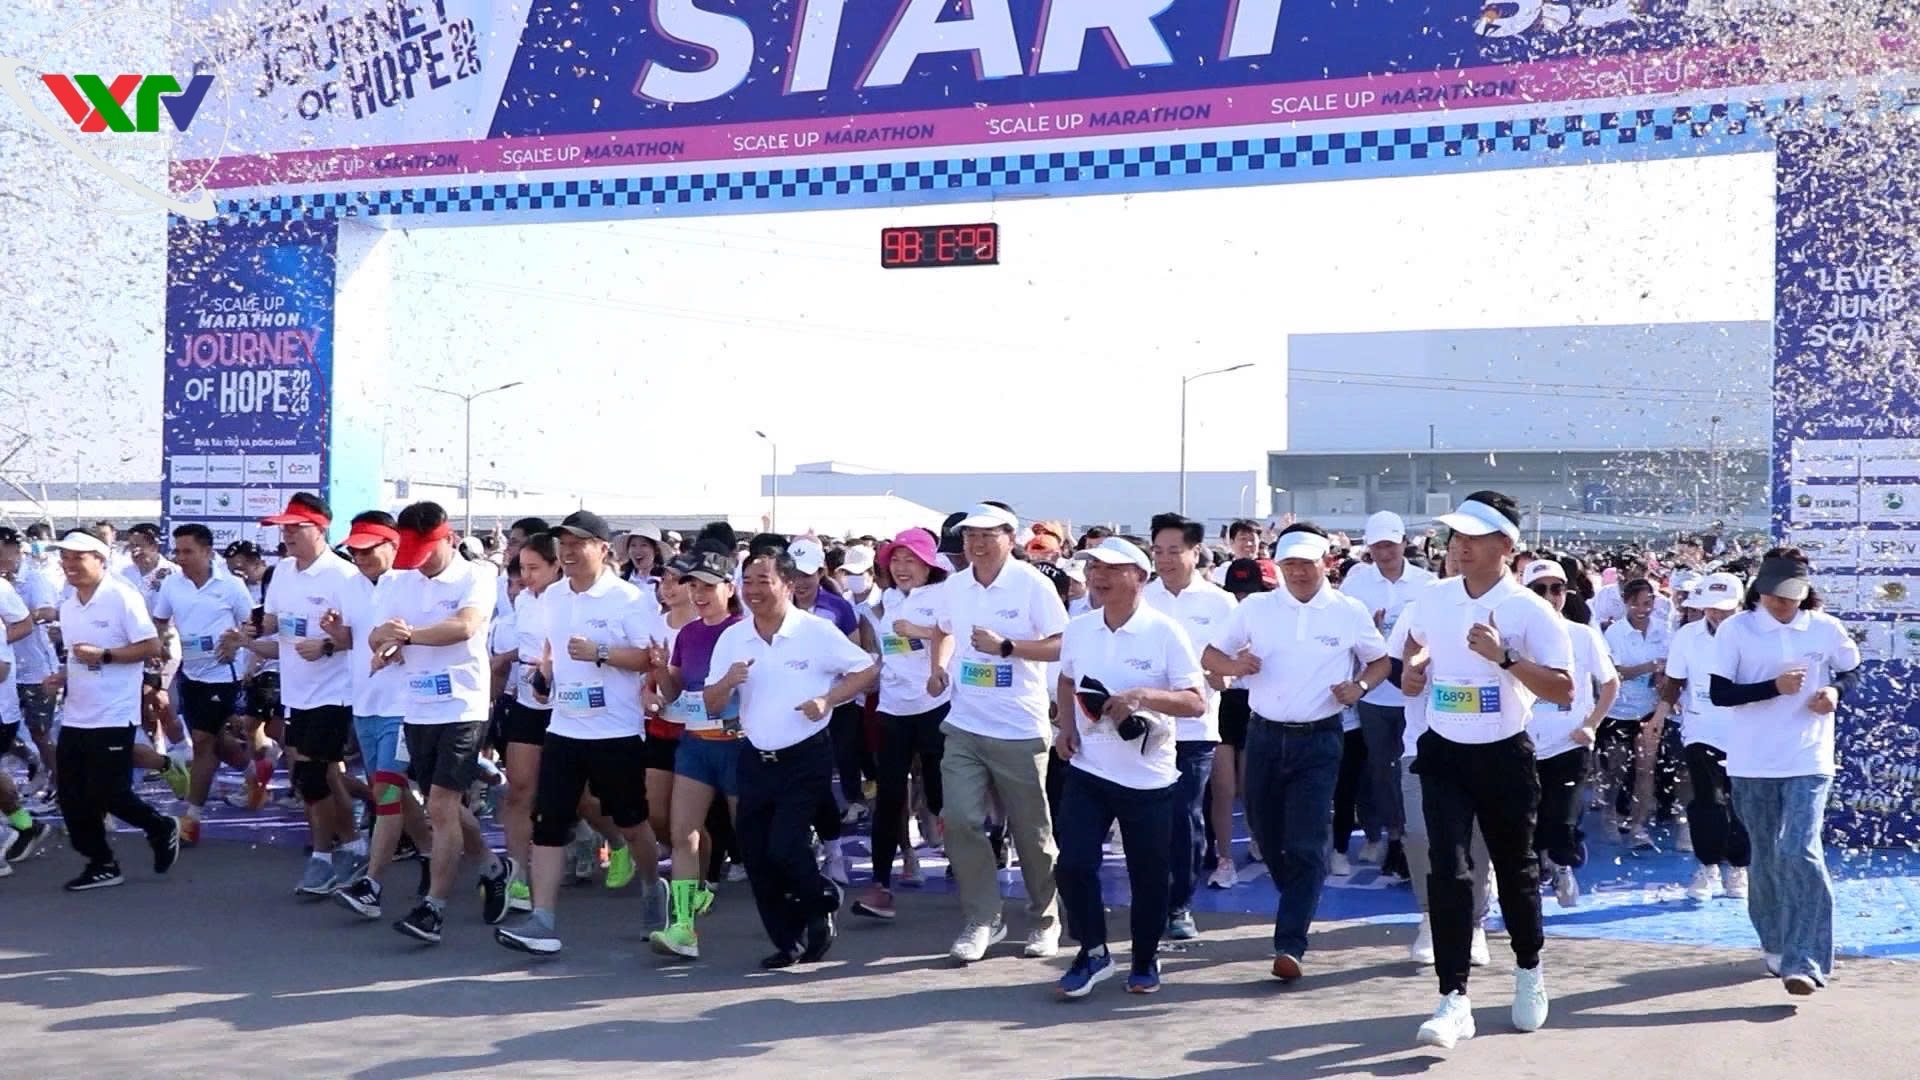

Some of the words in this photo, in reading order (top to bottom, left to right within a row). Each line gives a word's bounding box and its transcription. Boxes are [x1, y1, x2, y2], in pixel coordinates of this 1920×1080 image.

[299, 81, 338, 120] OF
[347, 29, 451, 120] HOPE
[1271, 92, 1341, 115] SCALE
[1343, 91, 1376, 109] UP
[1381, 79, 1517, 106] MARATHON
[989, 114, 1051, 136] SCALE
[1056, 113, 1084, 132] UP
[1088, 103, 1212, 130] MARATHON
[502, 148, 554, 165] SCALE
[557, 146, 581, 163] UP
[584, 141, 685, 160] MARATHON
[733, 133, 790, 153] SCALE
[794, 132, 820, 149] UP
[823, 124, 935, 146] MARATHON
[343, 159, 364, 174] UP
[214, 297, 259, 312] SCALE
[264, 296, 285, 310] UP
[198, 312, 300, 329] MARATHON
[177, 328, 320, 368] JOURNEY
[185, 378, 215, 401] OF
[220, 369, 289, 413] HOPE
[1436, 689, 1473, 703] T6893
